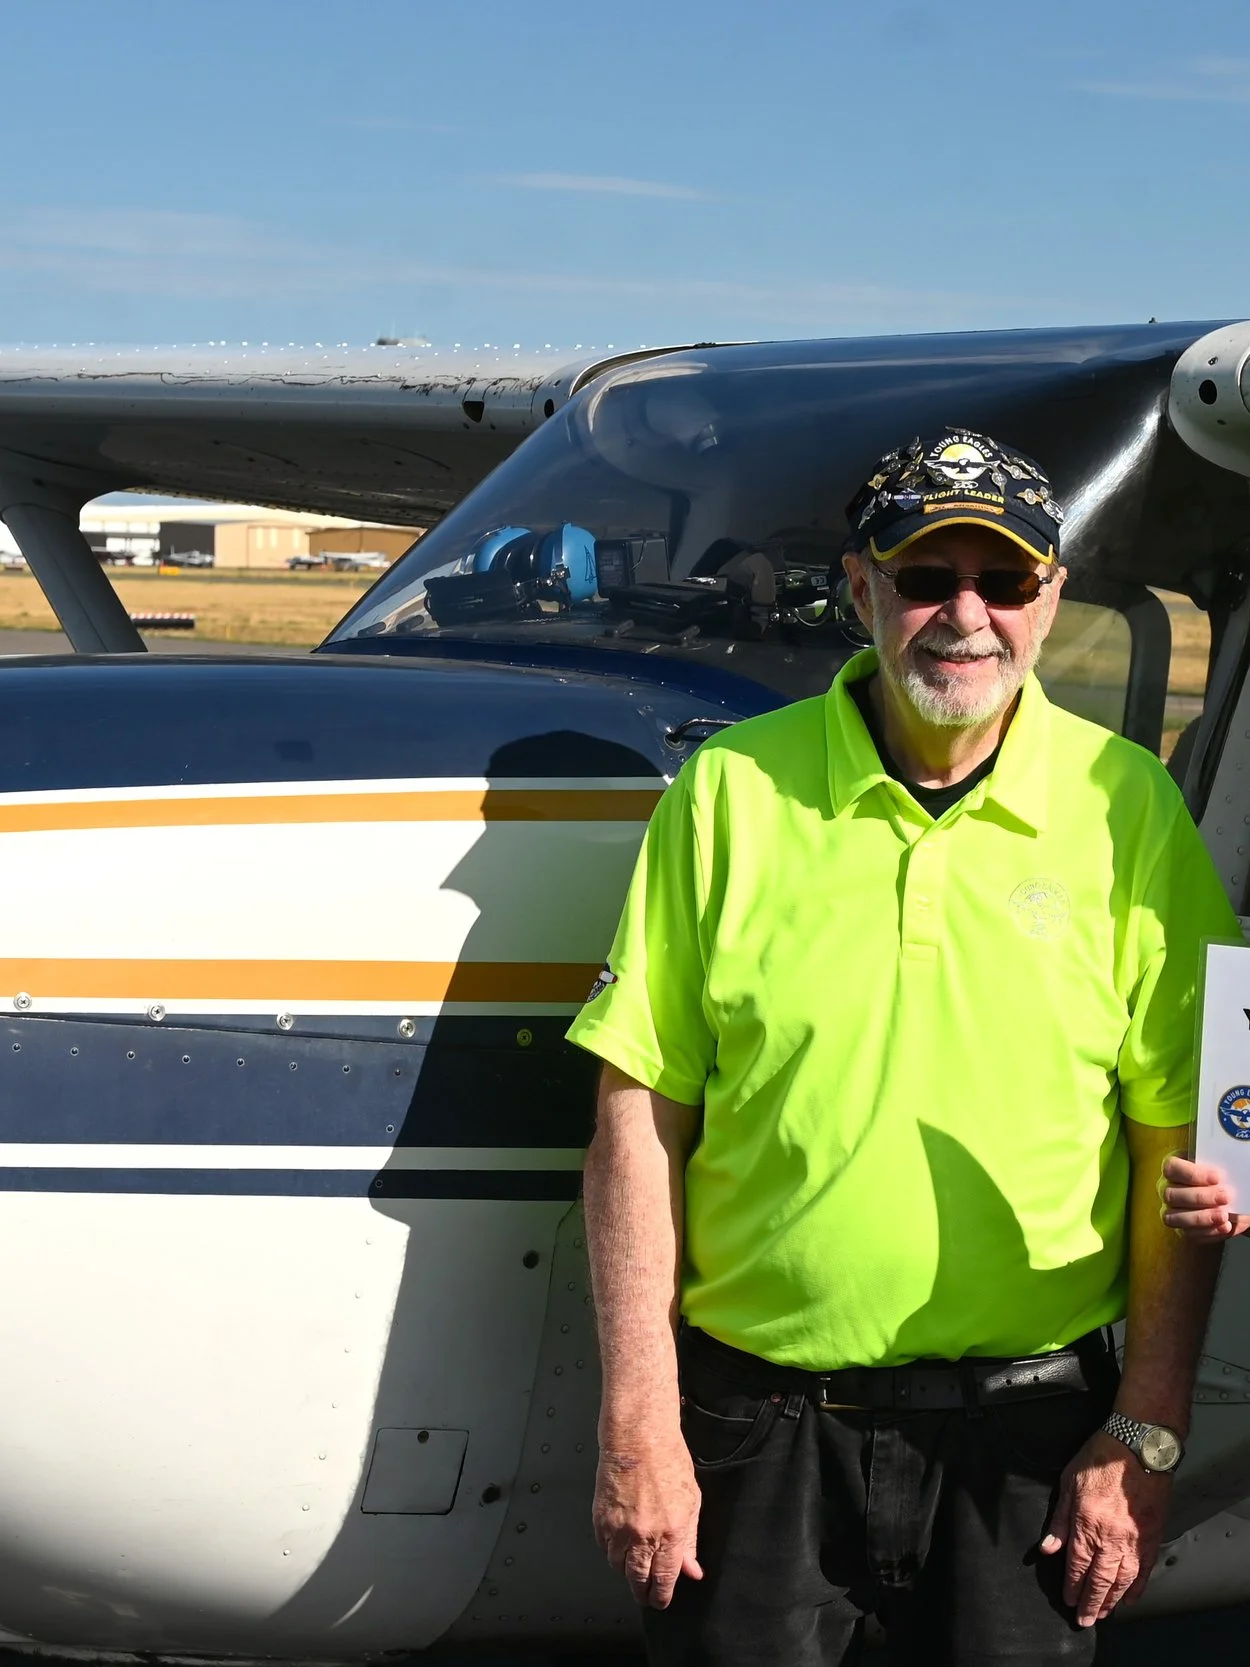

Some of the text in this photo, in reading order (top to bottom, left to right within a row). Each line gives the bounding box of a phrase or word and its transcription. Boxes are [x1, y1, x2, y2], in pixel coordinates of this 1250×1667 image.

[929, 435, 993, 458] YOUNG EAGLES
[923, 489, 1005, 504] FLIGHT LEADER
[1223, 1088, 1245, 1105] YOUNG
